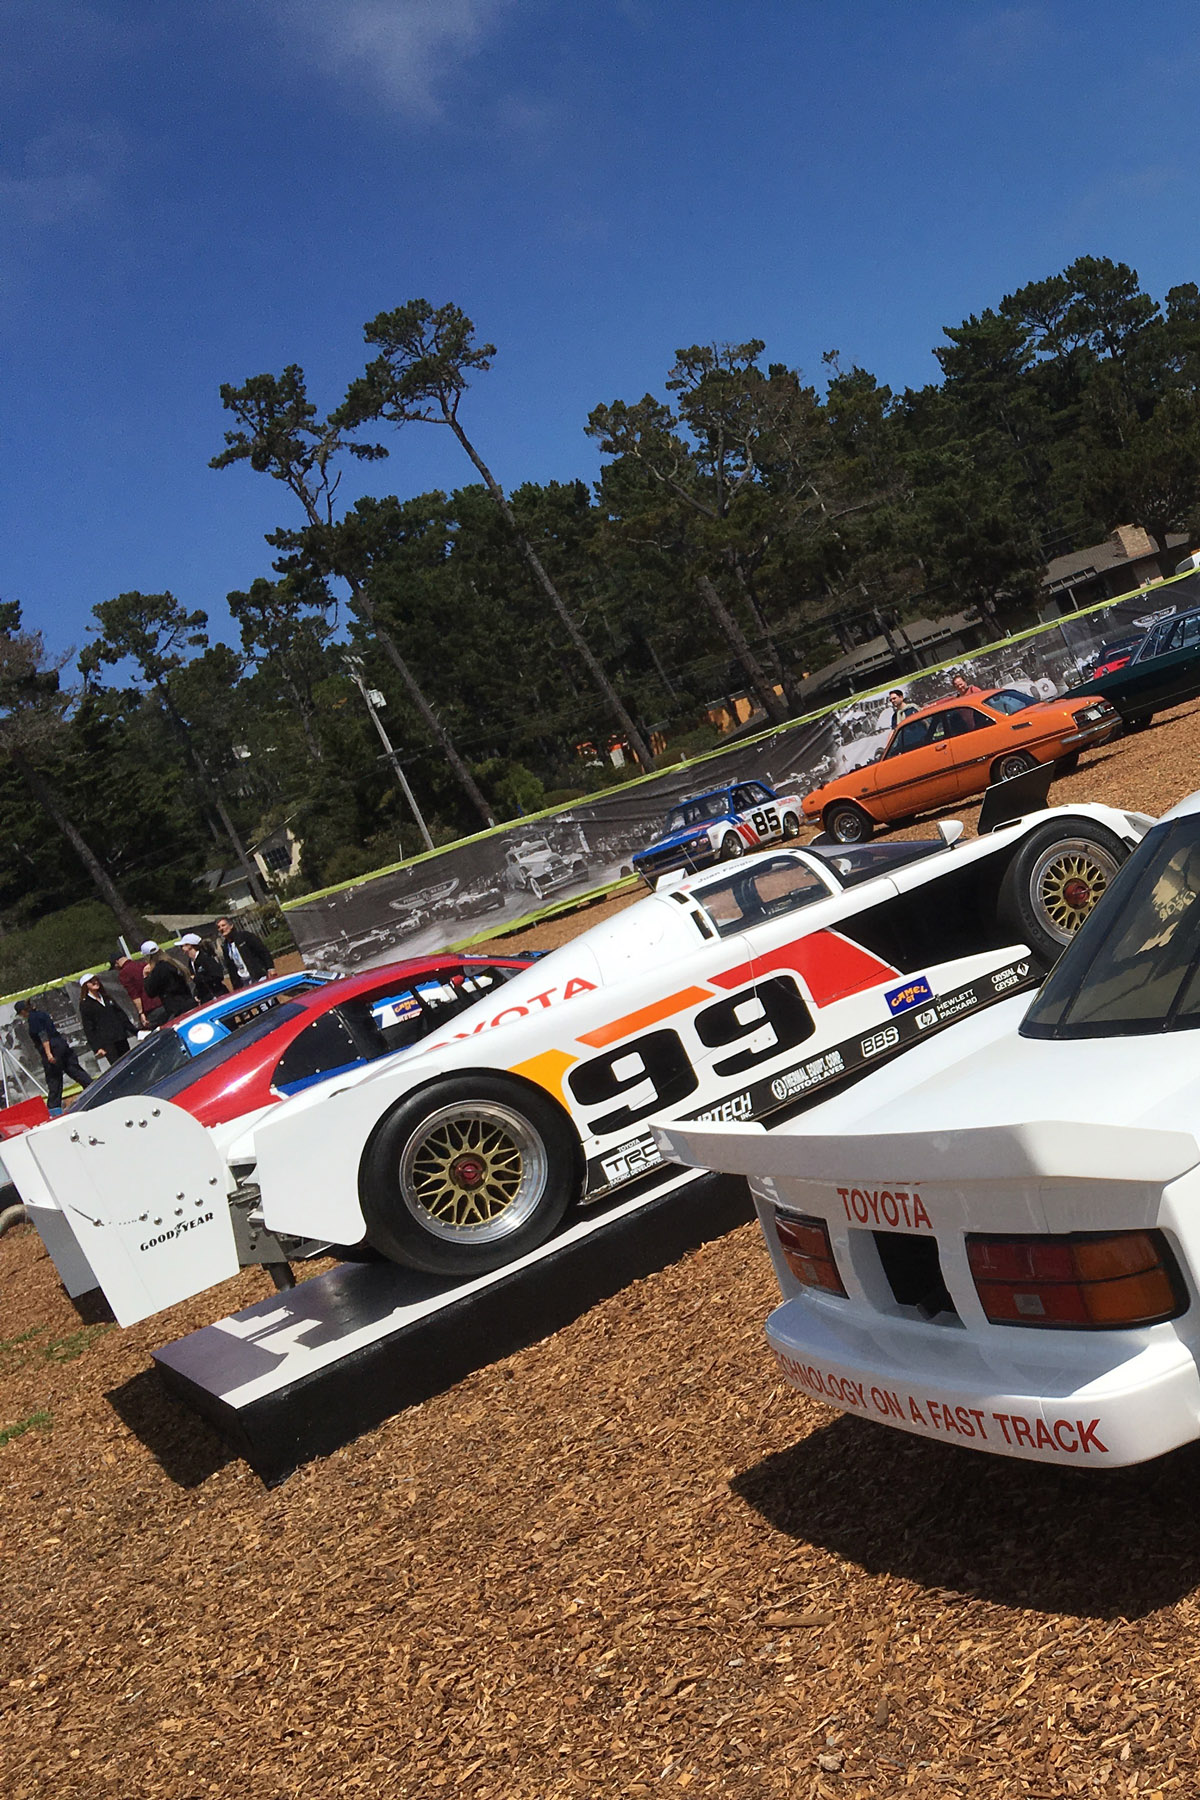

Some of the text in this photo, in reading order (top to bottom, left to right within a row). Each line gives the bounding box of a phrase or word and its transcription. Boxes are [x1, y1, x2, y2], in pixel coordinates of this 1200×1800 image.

[752, 807, 782, 837] 85
[991, 967, 1016, 985] CRYSTAL
[994, 975, 1020, 992] GEYSER
[891, 985, 928, 1007] CAMEL
[936, 989, 975, 1012] HEWLETT
[939, 996, 978, 1020] PACKARD
[568, 975, 816, 1136] 99
[861, 1026, 899, 1058] BBS
[787, 1063, 845, 1096] AUTOCLAVES
[617, 1138, 641, 1152] TOYOTA
[836, 1187, 933, 1230] TOYOTA
[139, 1212, 214, 1251] GOODYEAR
[870, 1386, 906, 1420] ON
[908, 1396, 928, 1426] A
[926, 1400, 988, 1440] FAST
[992, 1413, 1110, 1454] TRACK
